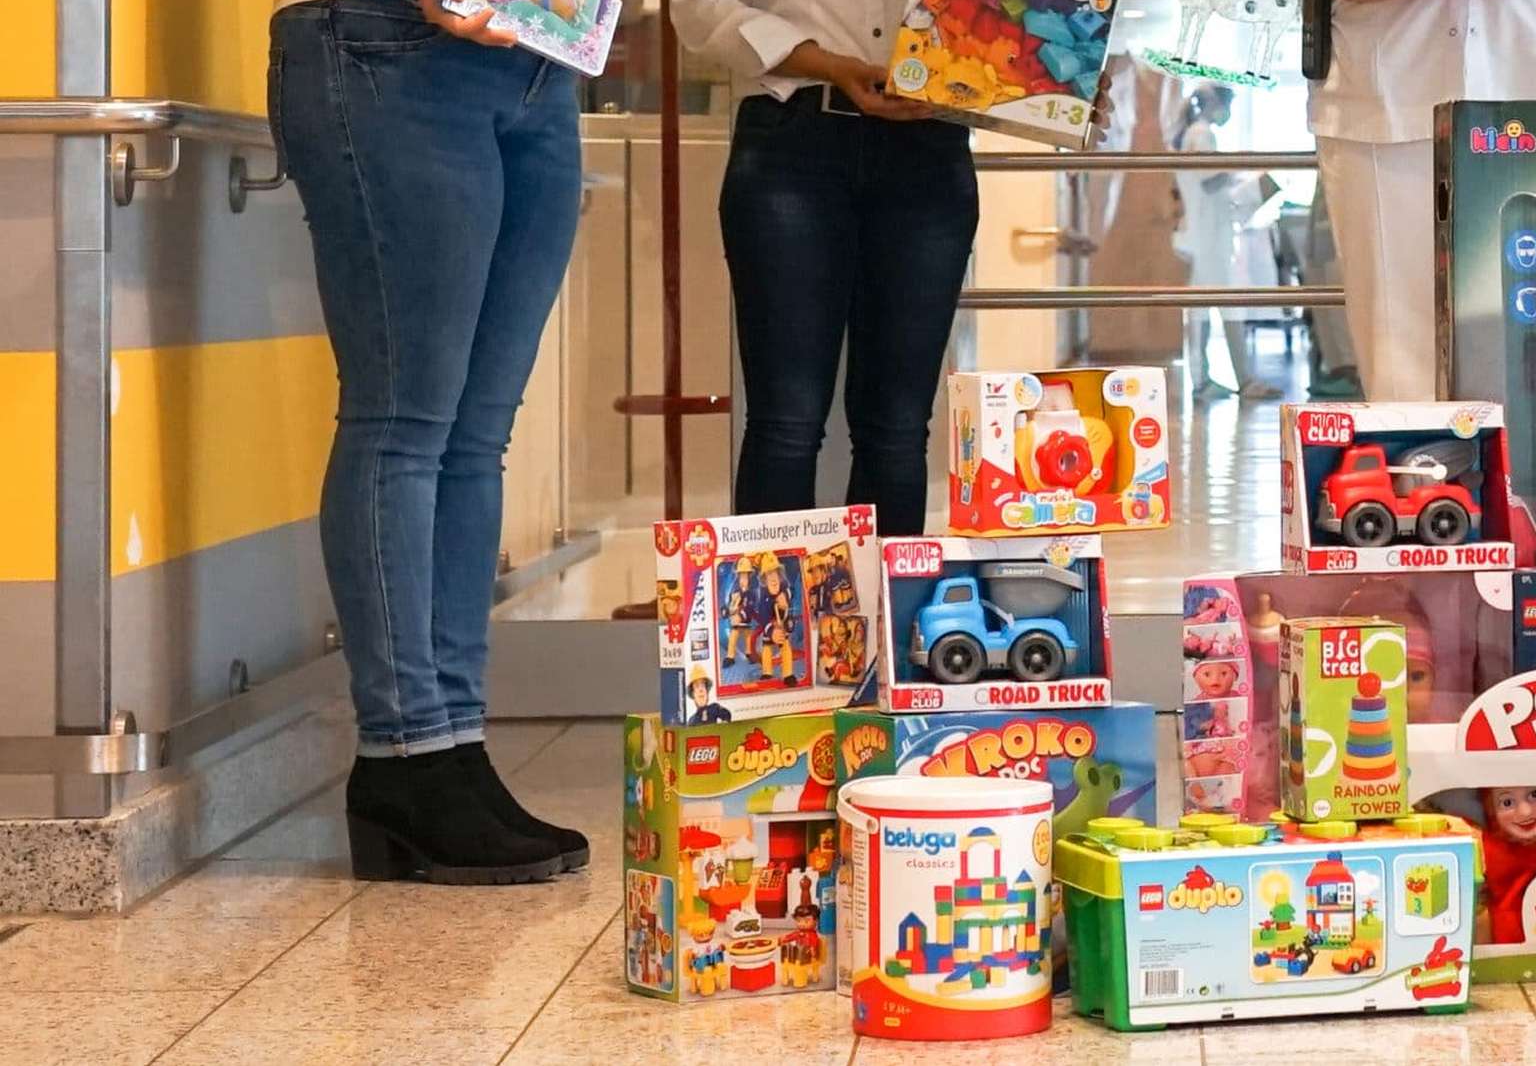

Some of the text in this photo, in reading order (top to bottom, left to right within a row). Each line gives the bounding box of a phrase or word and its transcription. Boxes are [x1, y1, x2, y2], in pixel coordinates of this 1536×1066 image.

[1472, 121, 1536, 153] klein
[1308, 427, 1350, 442] CLUB
[851, 512, 866, 528] 5+
[721, 518, 839, 543] Ravensburger Puzzle
[895, 558, 941, 573] CLUB
[1400, 548, 1509, 567] ROAD TRUCK
[1323, 661, 1360, 676] tree
[989, 684, 1105, 704] ROAD TRUCK
[911, 698, 941, 707] CLUB
[688, 748, 718, 763] LEGO
[923, 722, 1093, 777] KROKO
[727, 743, 798, 775] duplo
[999, 756, 1041, 779] DOC
[1334, 783, 1401, 799] RAINBOW
[1352, 801, 1401, 815] TOWER
[884, 825, 956, 855] beluga
[906, 859, 955, 868] classics
[1167, 882, 1244, 914] duplo
[1414, 897, 1423, 913] 3
